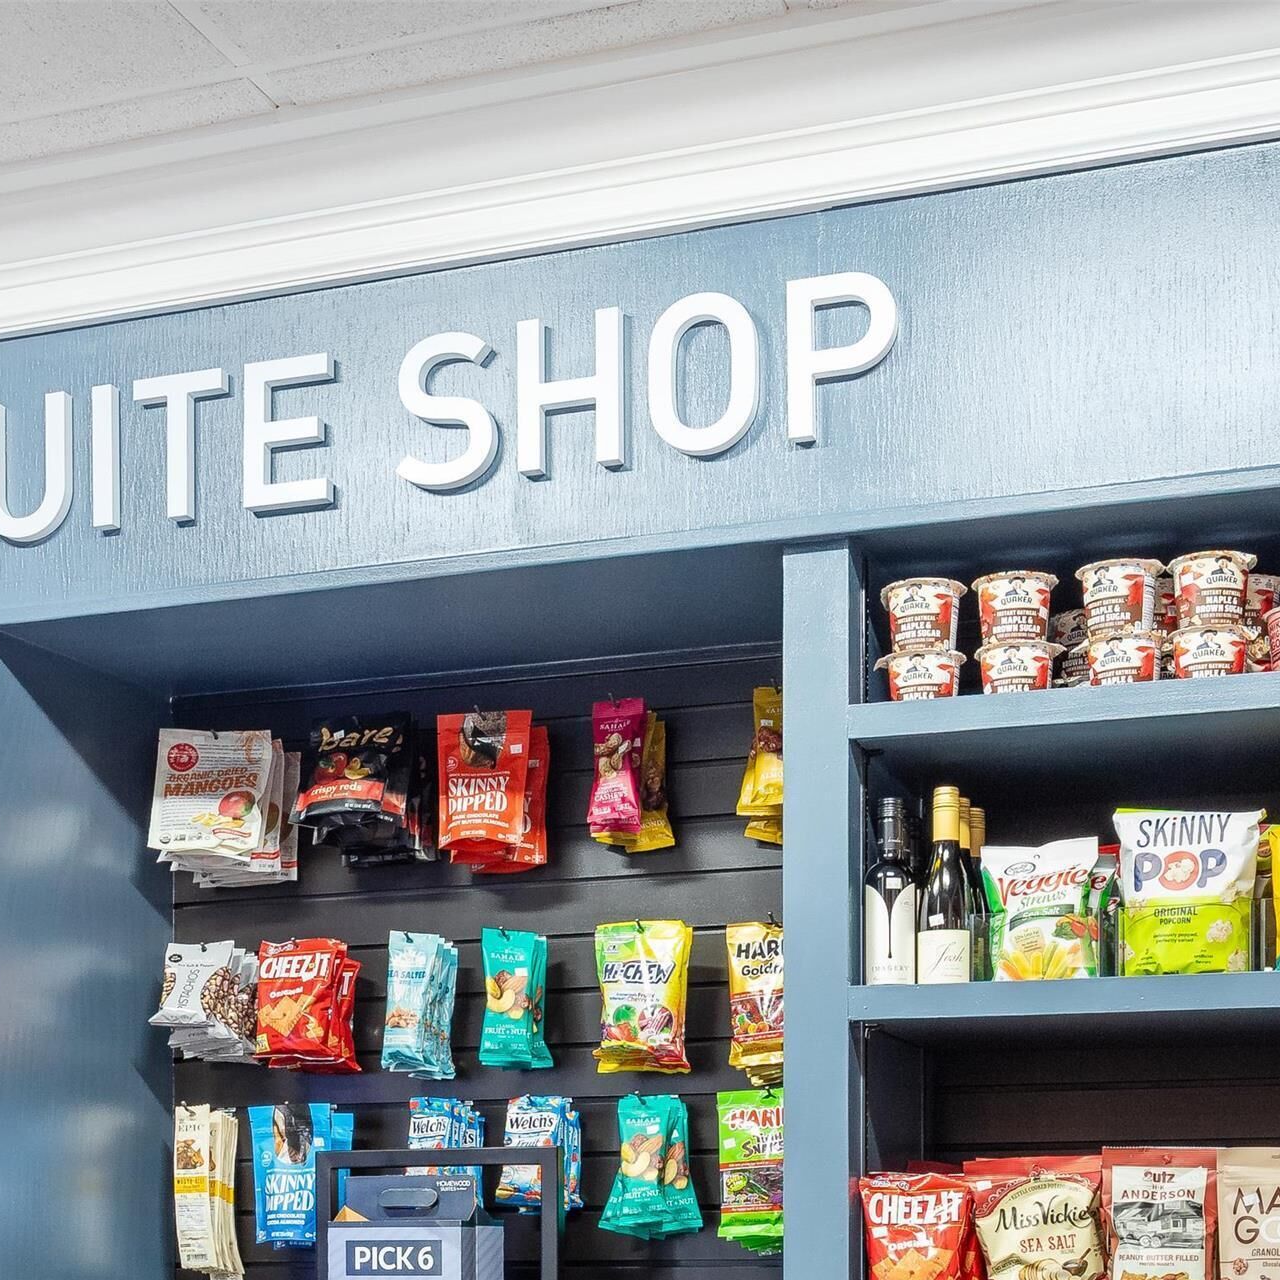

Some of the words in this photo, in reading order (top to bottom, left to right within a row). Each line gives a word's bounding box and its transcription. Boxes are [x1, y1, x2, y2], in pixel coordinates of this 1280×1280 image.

[394, 270, 900, 497] SHOP
[1207, 576, 1238, 585] QUAKER
[1090, 586, 1118, 597] QUAKER
[1000, 596, 1033, 605] QUAKER
[1206, 596, 1230, 604] MAPLE
[900, 602, 930, 613] QUAKER
[1195, 605, 1221, 613] BROWN
[1001, 616, 1026, 624] MAPLE
[1106, 612, 1131, 621] SUGAR
[1020, 625, 1040, 633] SUGAR
[1192, 650, 1225, 659] QUAKER
[1099, 656, 1132, 667] QUAKER
[997, 665, 1028, 674] QUAKER
[902, 673, 933, 682] QUAKER
[318, 726, 394, 752] bare
[164, 773, 258, 798] MANGOES
[449, 777, 509, 797] SKINNY
[449, 791, 508, 815] DIPPED
[1134, 849, 1227, 892] POP
[997, 868, 1089, 907] Veggie
[1017, 890, 1066, 912] Straws
[1154, 907, 1198, 918] ORIGINAL
[1160, 917, 1191, 925] POPCORN
[508, 1114, 555, 1131] Welch's
[730, 1108, 783, 1129] HARI
[178, 1124, 204, 1132] EPIC
[412, 1116, 448, 1135] Welch's
[266, 1172, 316, 1196] SKINNY
[1122, 1189, 1196, 1200] ANDERSON
[995, 1207, 1040, 1233] Miss
[1020, 1238, 1043, 1253] SEA
[1048, 1234, 1076, 1250] SALT
[354, 1246, 414, 1270] PICK
[417, 1246, 434, 1270] 6
